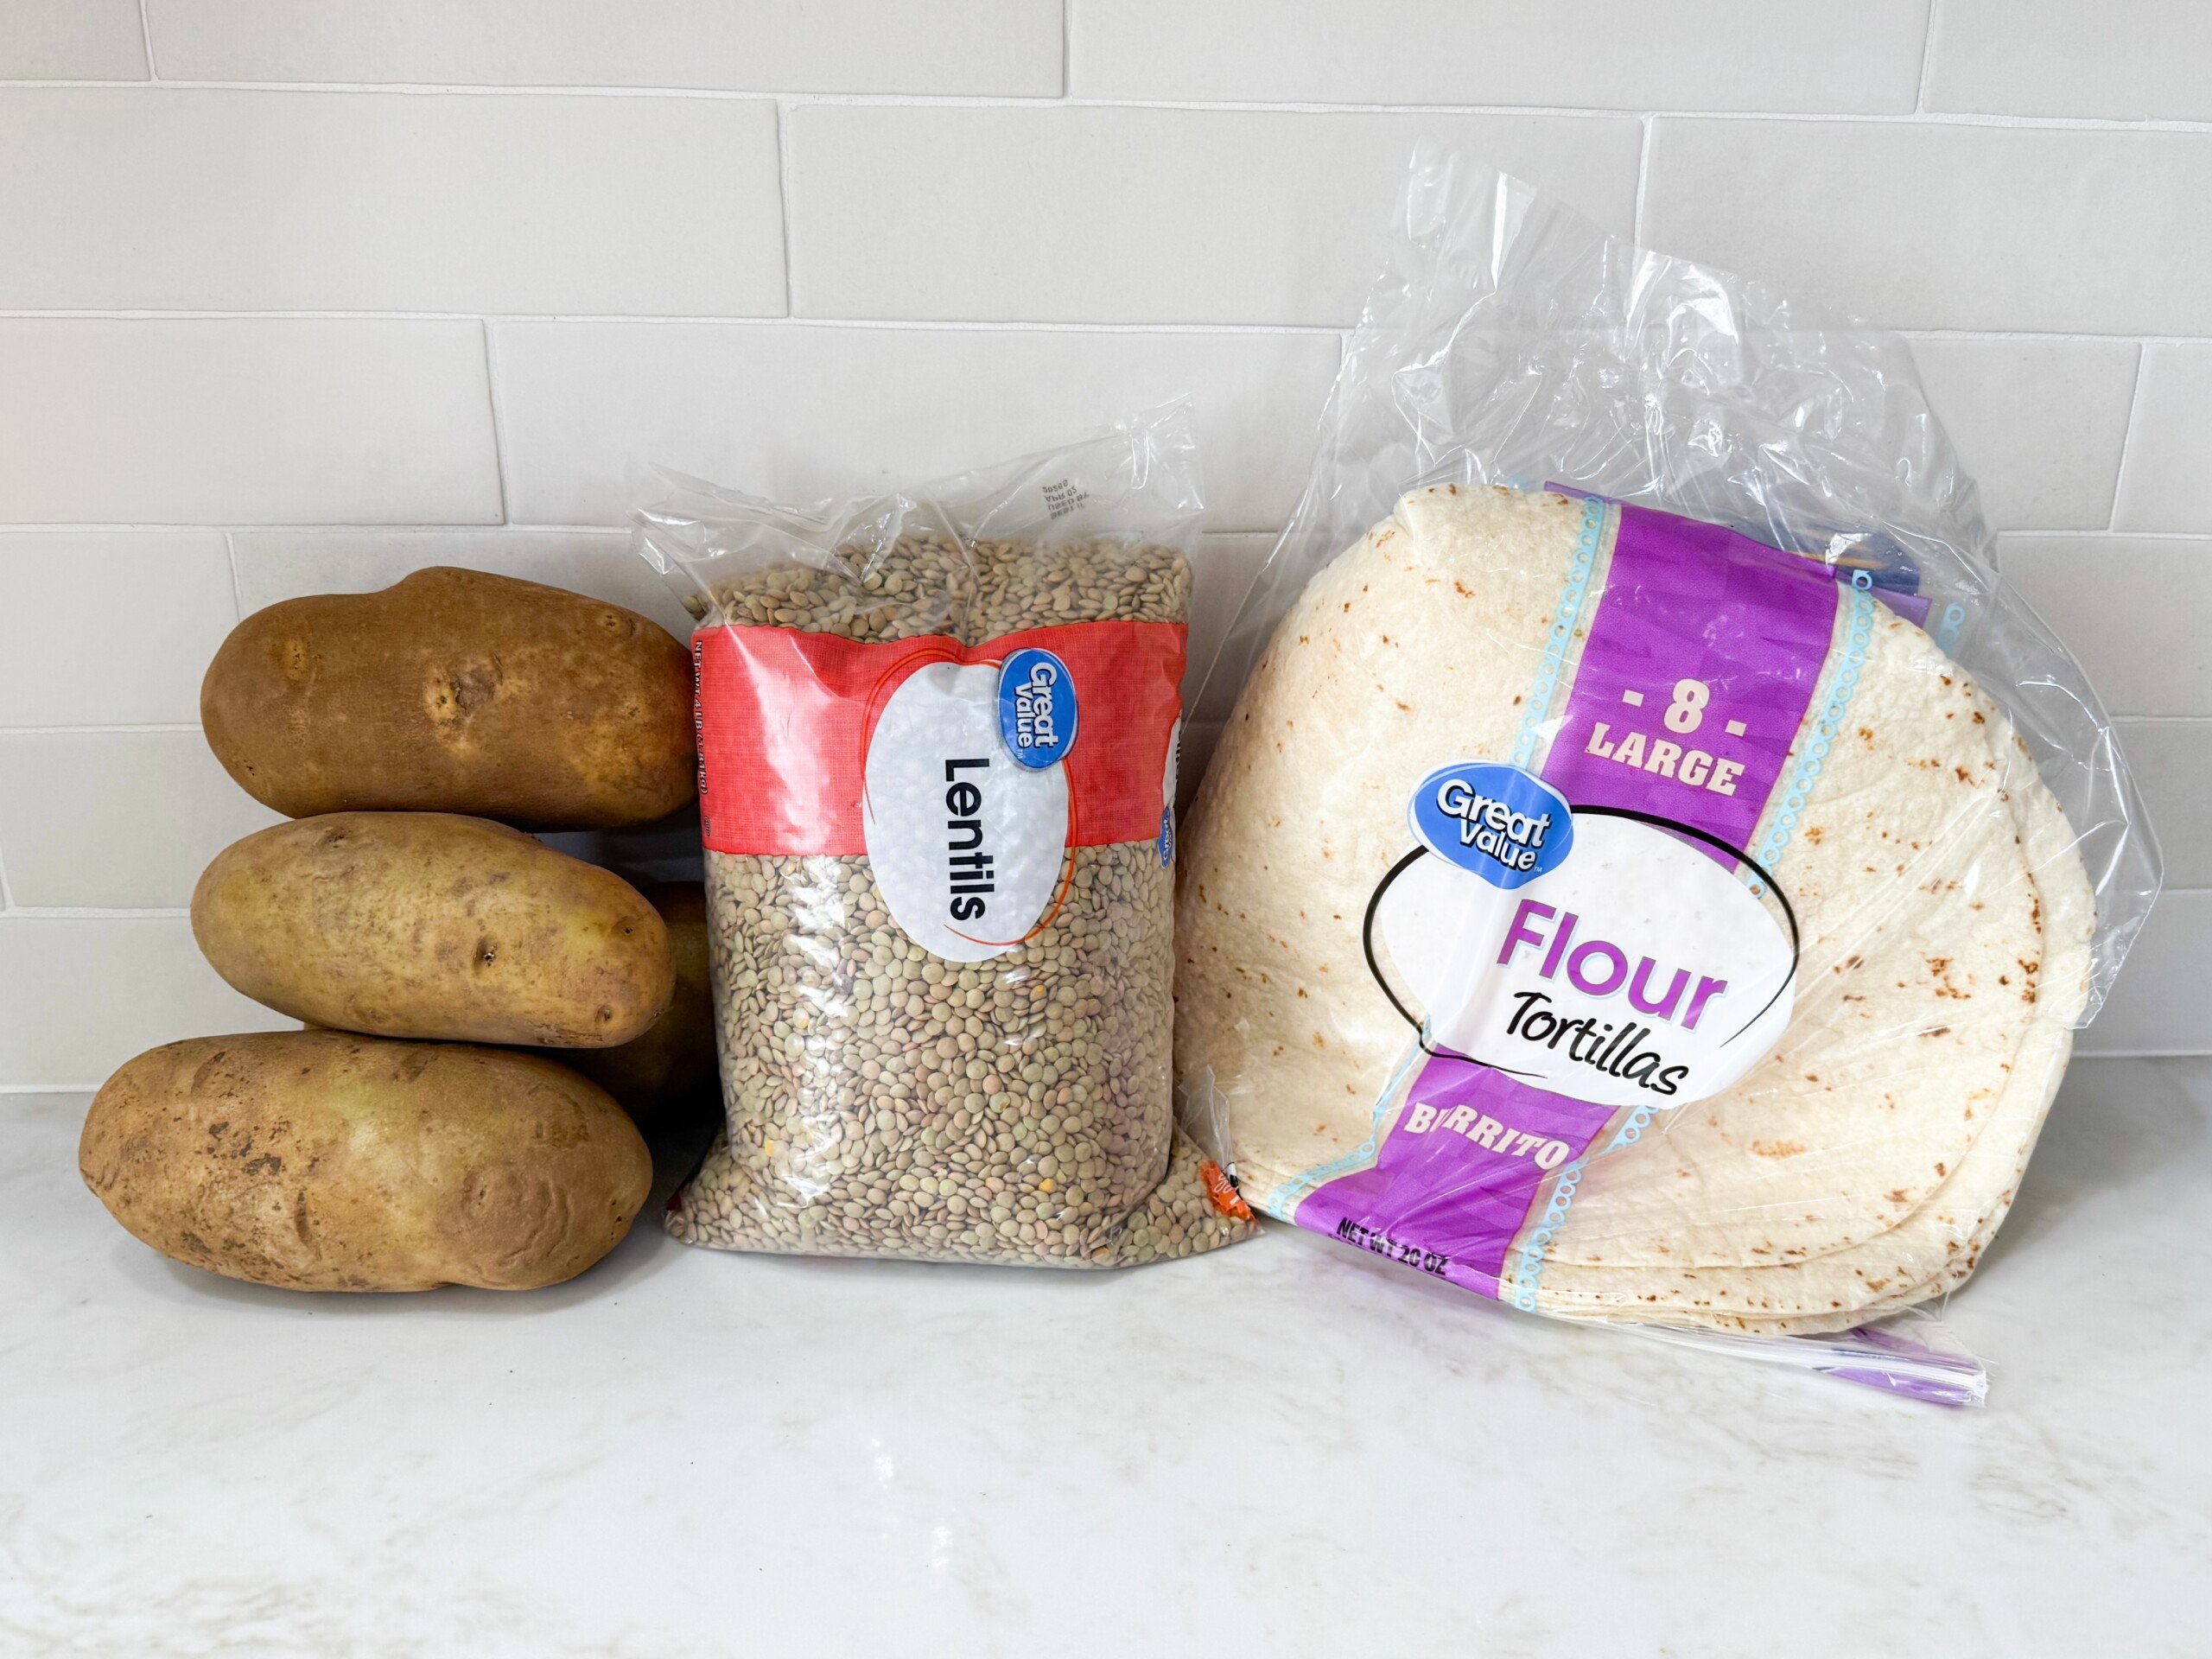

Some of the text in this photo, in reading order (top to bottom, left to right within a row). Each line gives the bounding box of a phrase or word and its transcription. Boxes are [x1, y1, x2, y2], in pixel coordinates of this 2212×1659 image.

[694, 640, 702, 670] NET
[695, 711, 703, 731] LB
[1014, 681, 1036, 749] Value
[1029, 662, 1059, 748] Great
[1663, 678, 1711, 734] 8
[1585, 722, 1746, 796] LARGE
[944, 758, 995, 922] Lentils
[1436, 779, 1551, 849] Great
[1460, 818, 1538, 873] Value
[1497, 899, 1728, 1033] Flour
[1505, 991, 1689, 1096] Tortillas
[1337, 1217, 1448, 1275] NET WT 20 OZ
